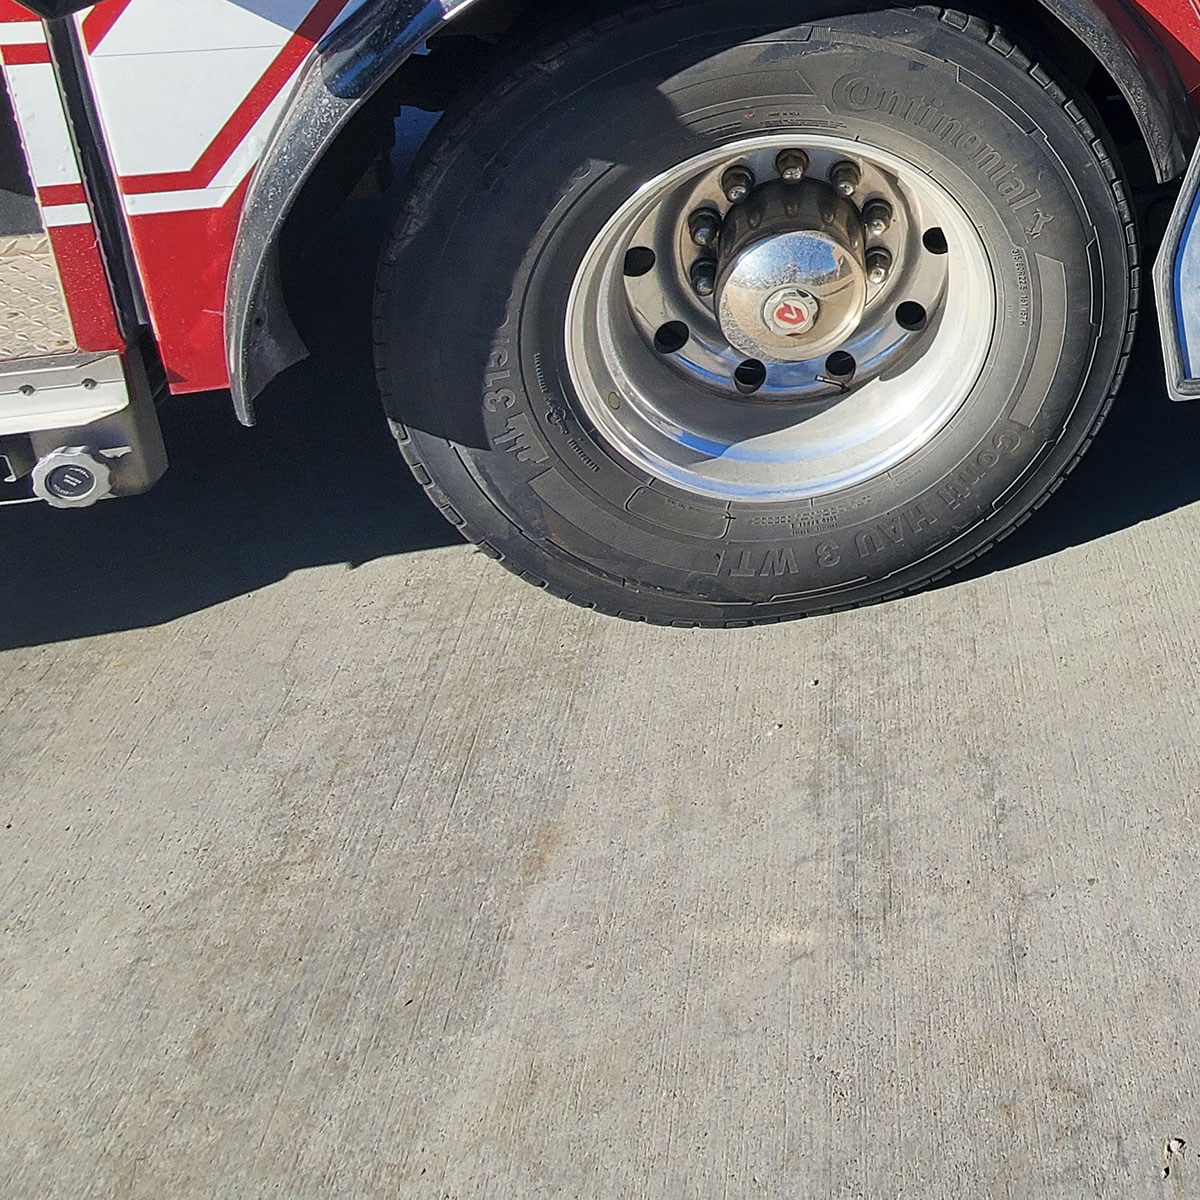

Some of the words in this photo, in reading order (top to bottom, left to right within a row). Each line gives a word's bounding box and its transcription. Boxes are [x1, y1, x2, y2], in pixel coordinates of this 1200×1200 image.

[831, 72, 1042, 214] Continental
[938, 431, 1021, 510] Conti
[815, 541, 841, 568] 3
[854, 506, 938, 558] HAU
[729, 546, 800, 578] WT
